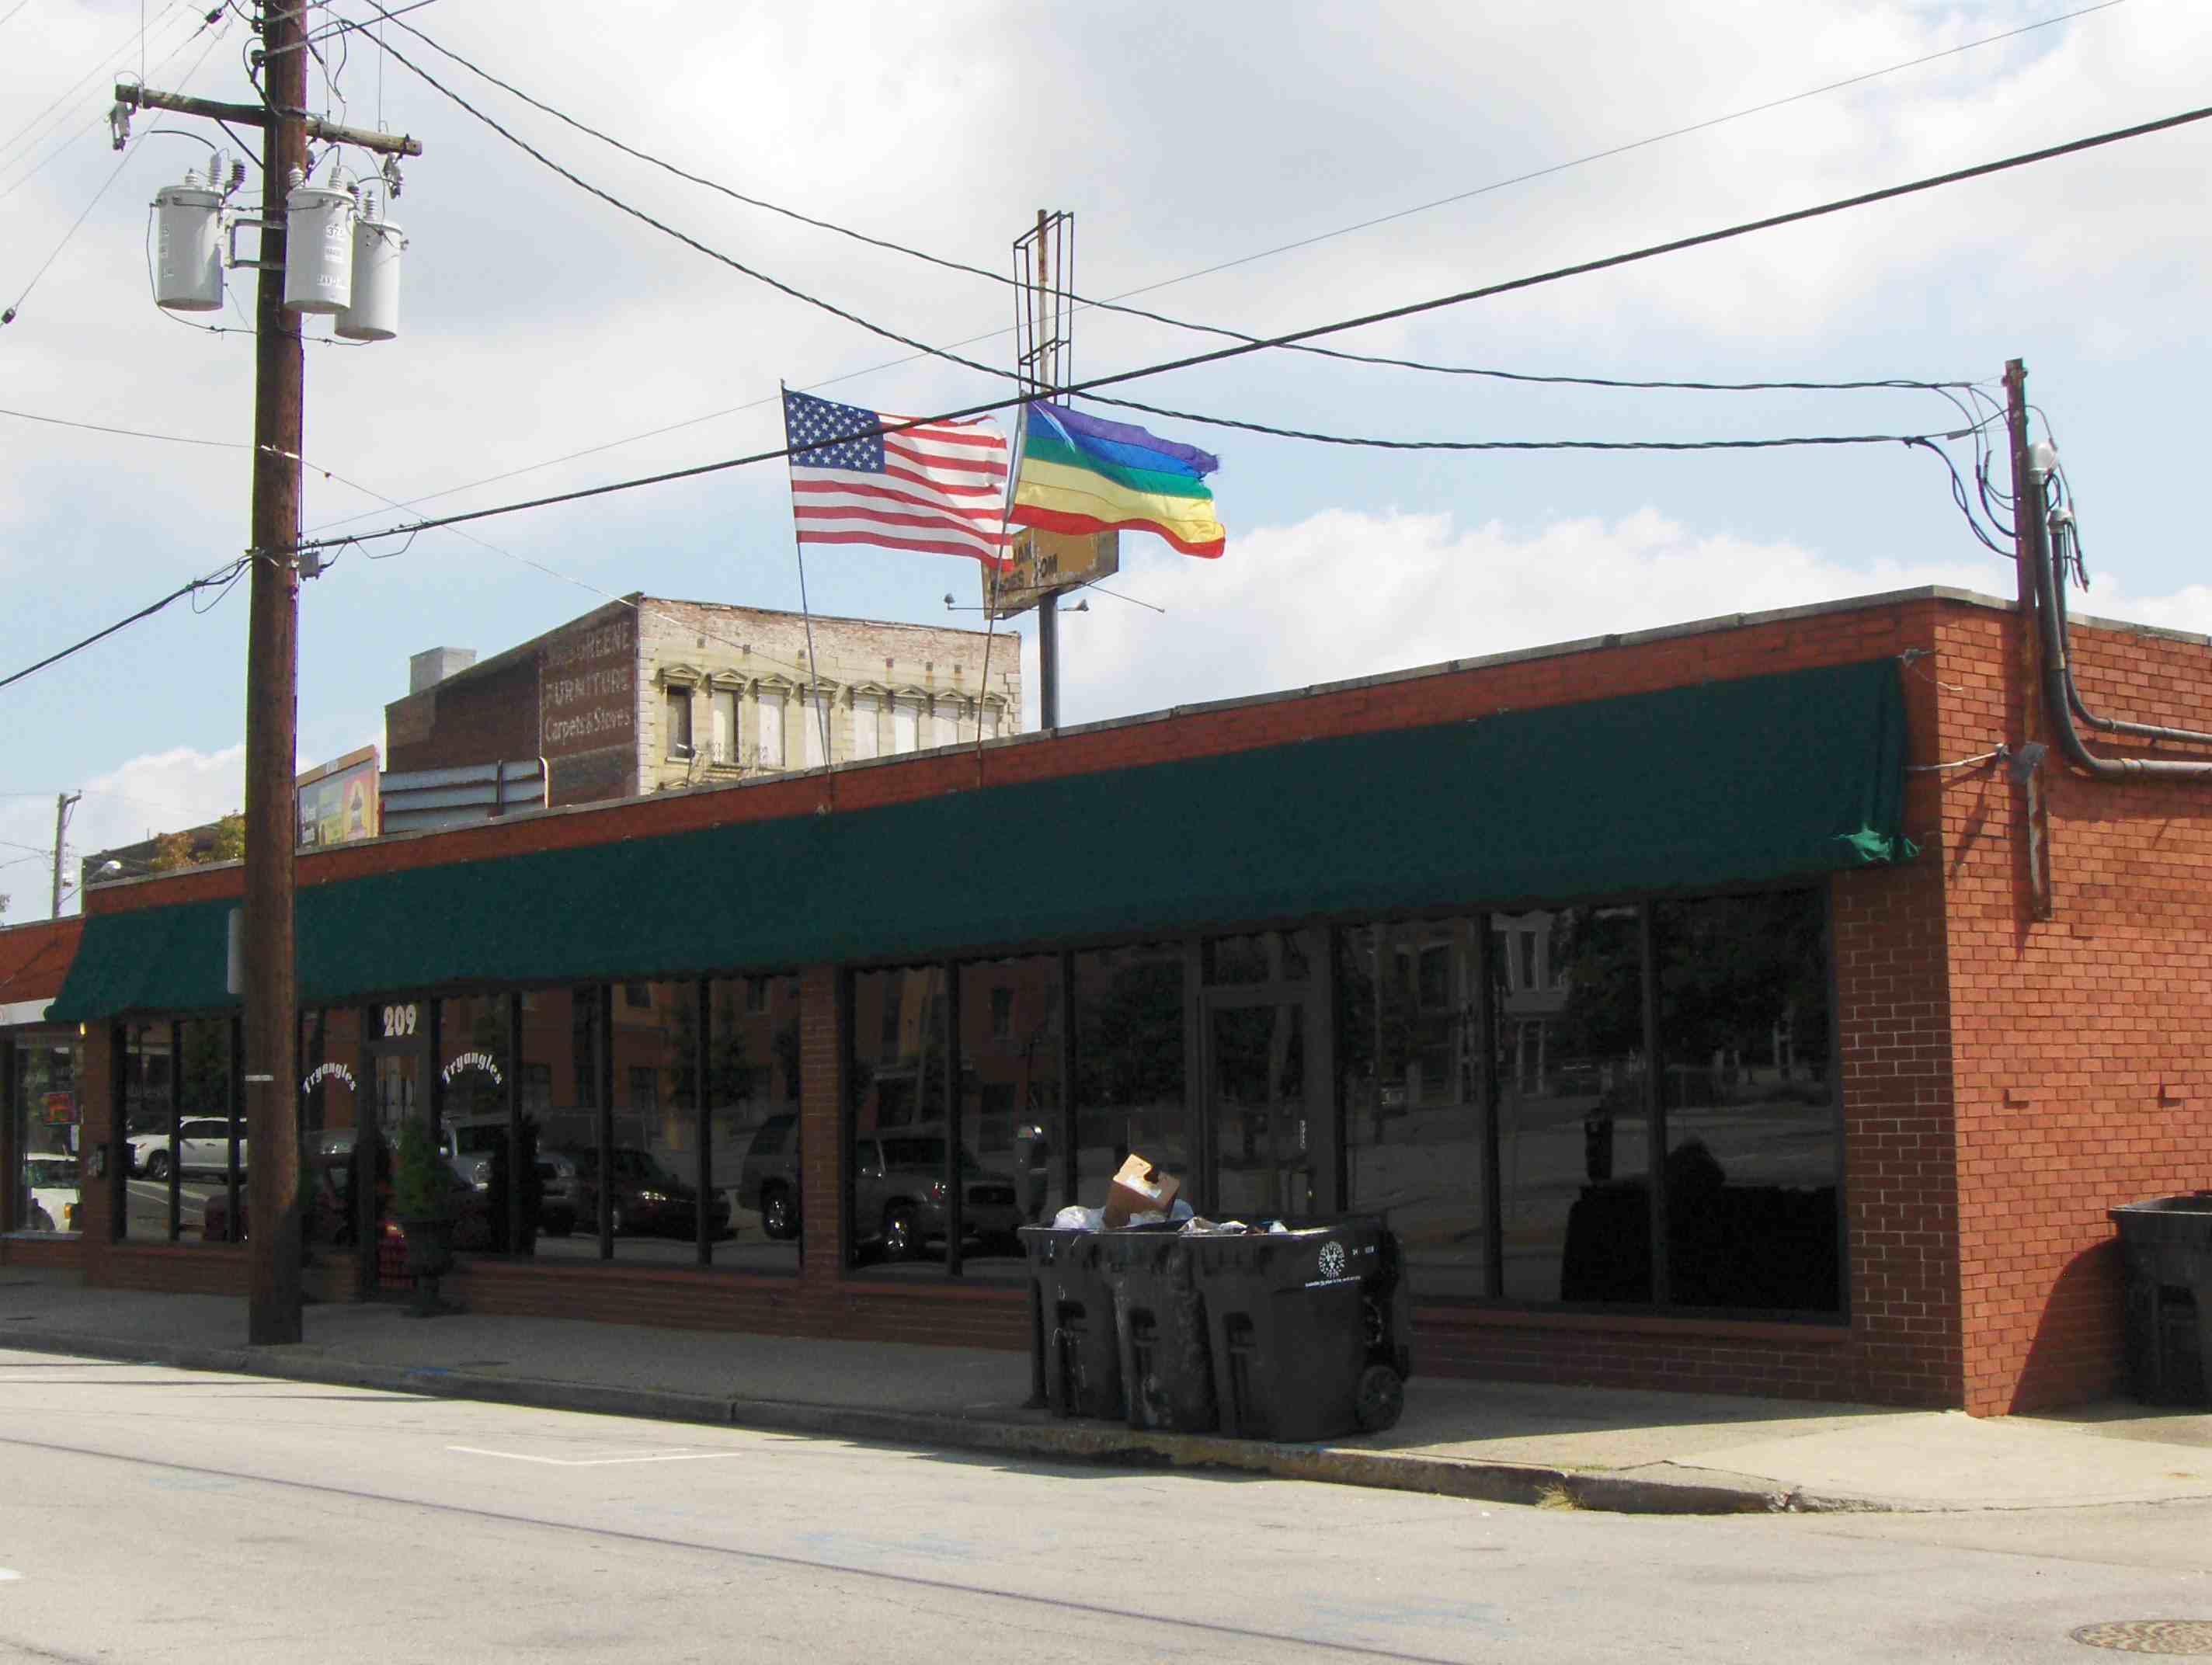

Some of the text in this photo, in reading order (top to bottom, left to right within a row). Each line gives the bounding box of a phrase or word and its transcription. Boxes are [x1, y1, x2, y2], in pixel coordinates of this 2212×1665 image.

[544, 666, 631, 709] FURNITURE
[384, 1005, 416, 1037] 209
[441, 1052, 503, 1084] Tryangles
